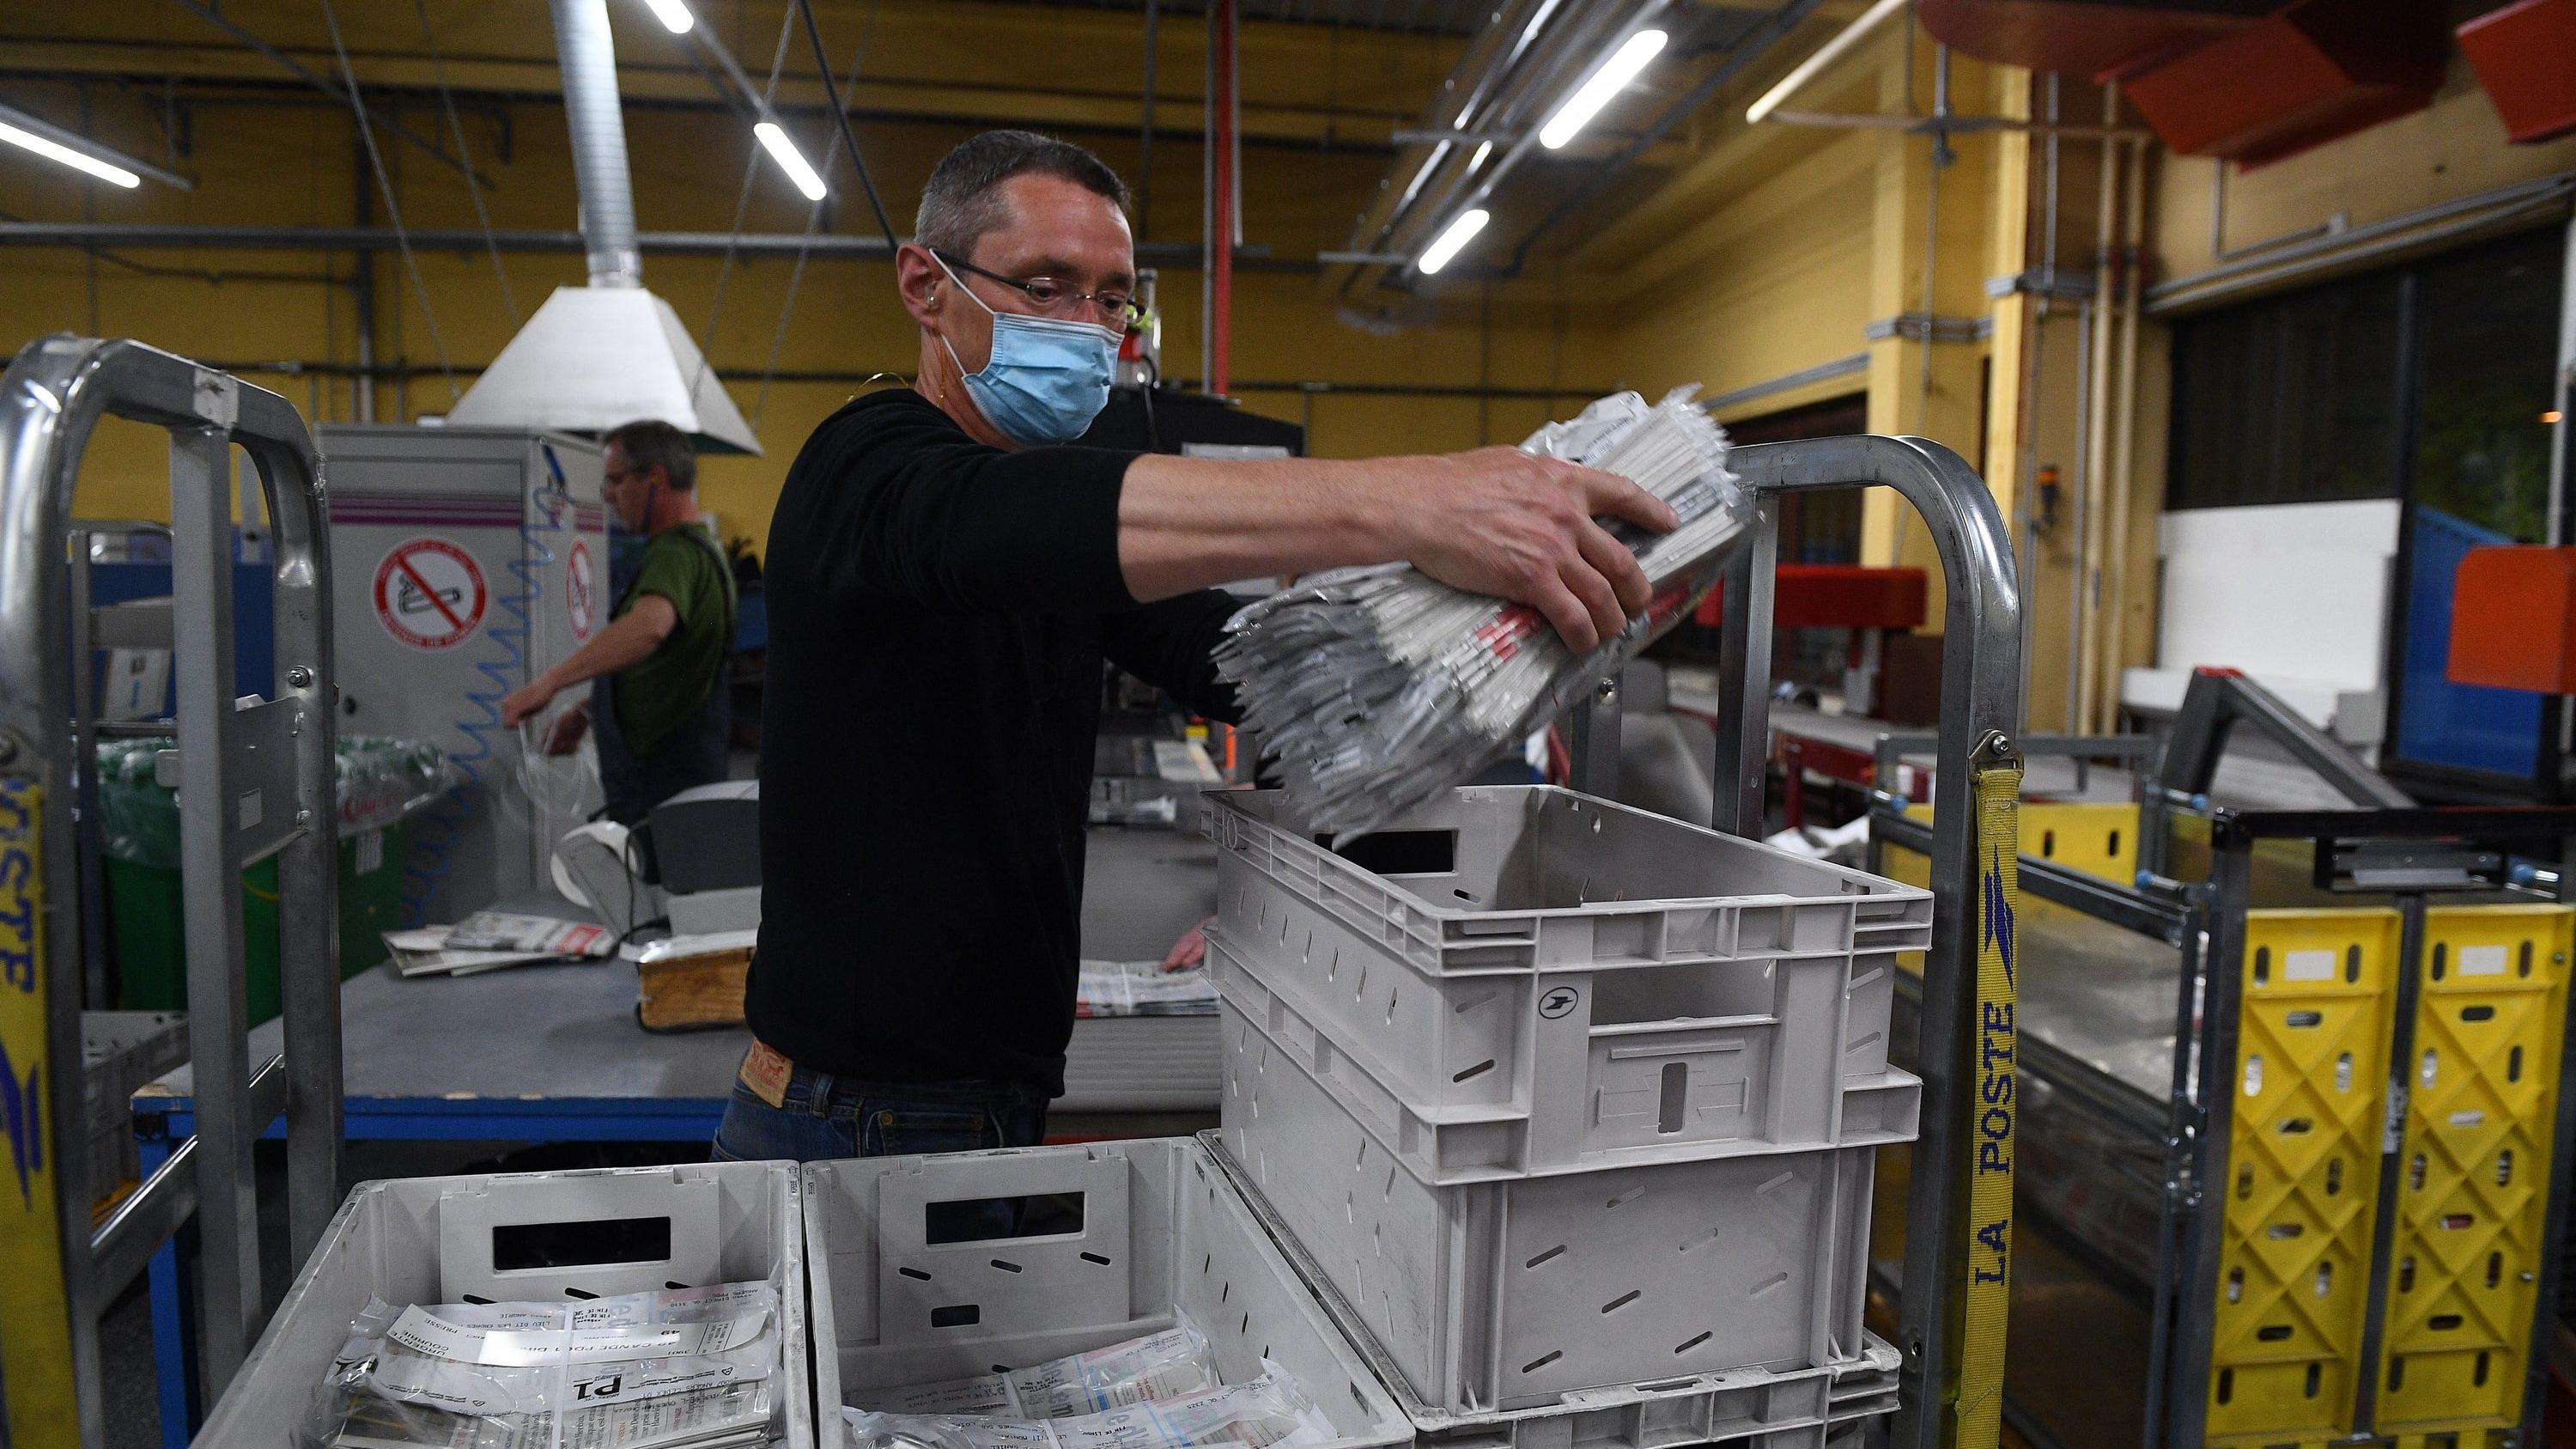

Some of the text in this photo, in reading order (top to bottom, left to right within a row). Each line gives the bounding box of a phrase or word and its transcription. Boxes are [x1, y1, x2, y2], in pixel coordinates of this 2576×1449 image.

[0, 777, 35, 994] OSTE
[1975, 1001, 2014, 1287] LA POSTE
[425, 1318, 459, 1334] PRESSE
[573, 1374, 623, 1402] P1
